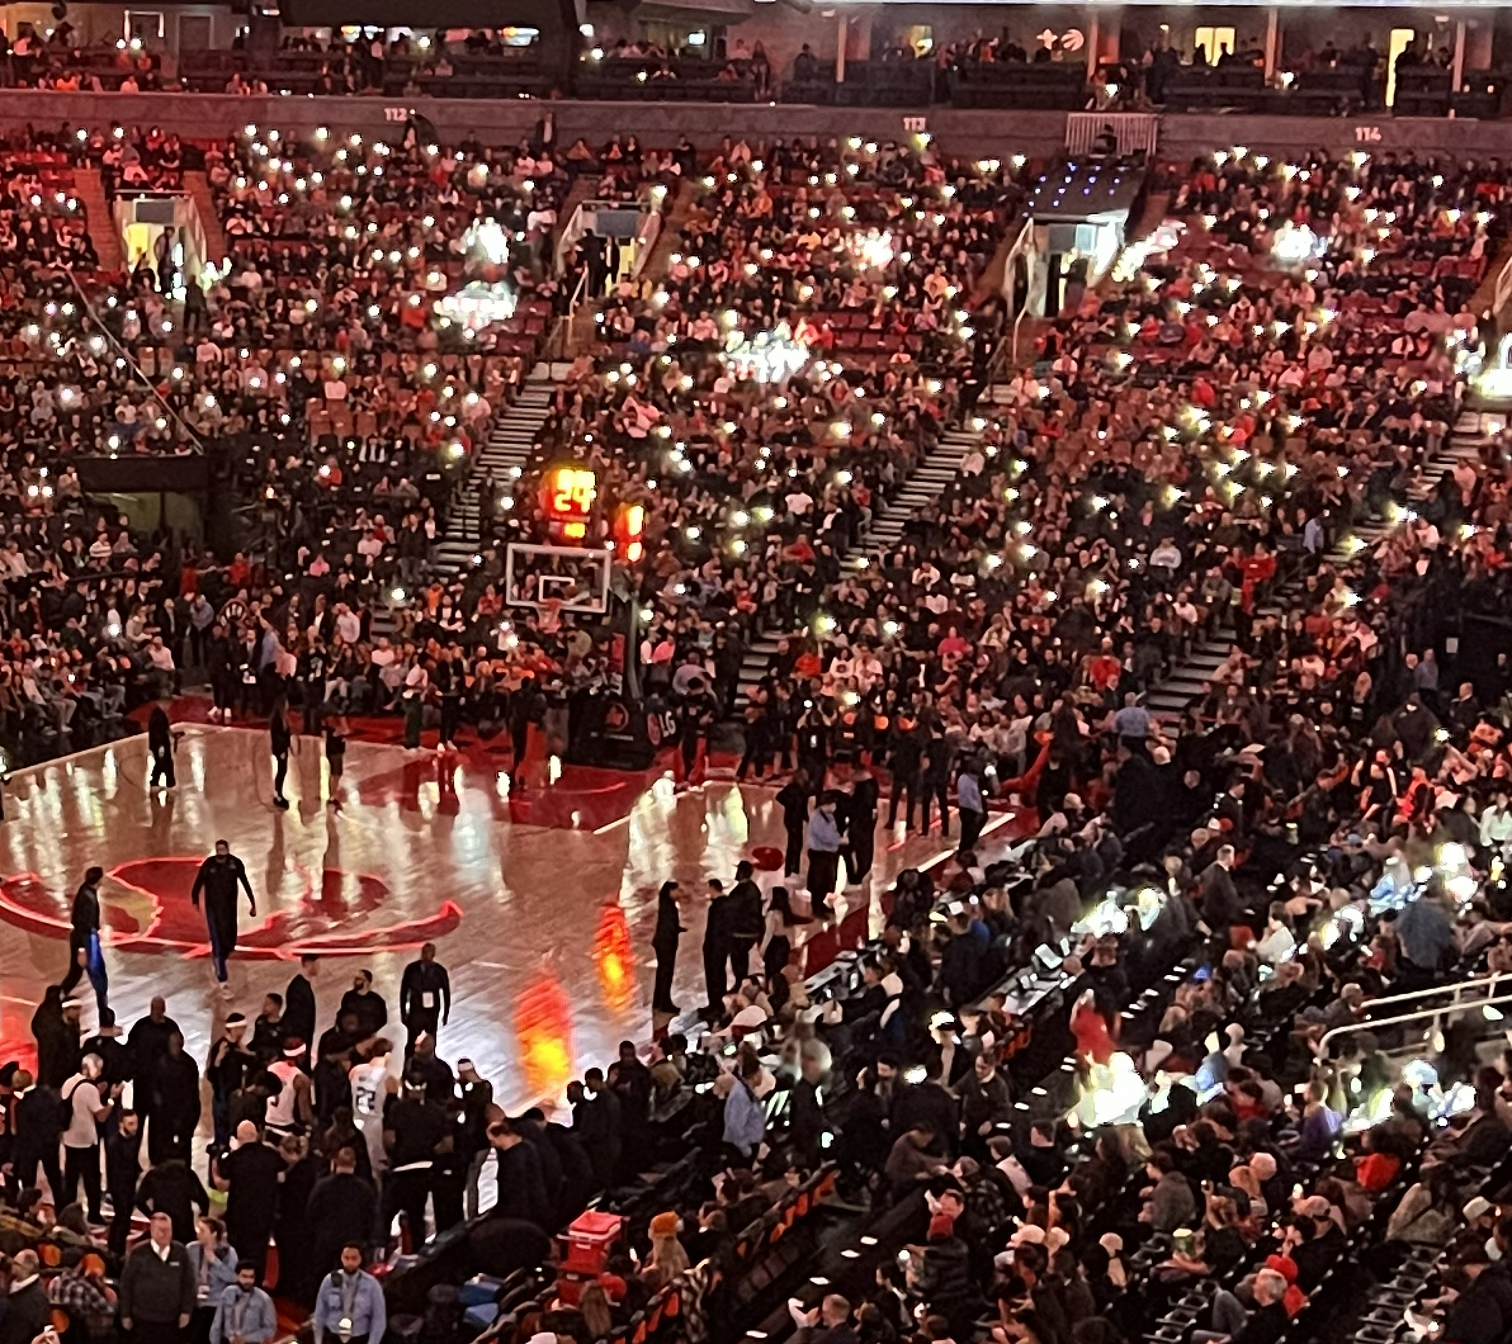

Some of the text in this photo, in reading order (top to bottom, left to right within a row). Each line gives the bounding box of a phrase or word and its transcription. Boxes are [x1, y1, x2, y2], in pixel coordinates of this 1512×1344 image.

[383, 107, 408, 123] 112
[903, 116, 927, 132] 113
[1354, 127, 1383, 142] 114
[554, 487, 593, 514] 24
